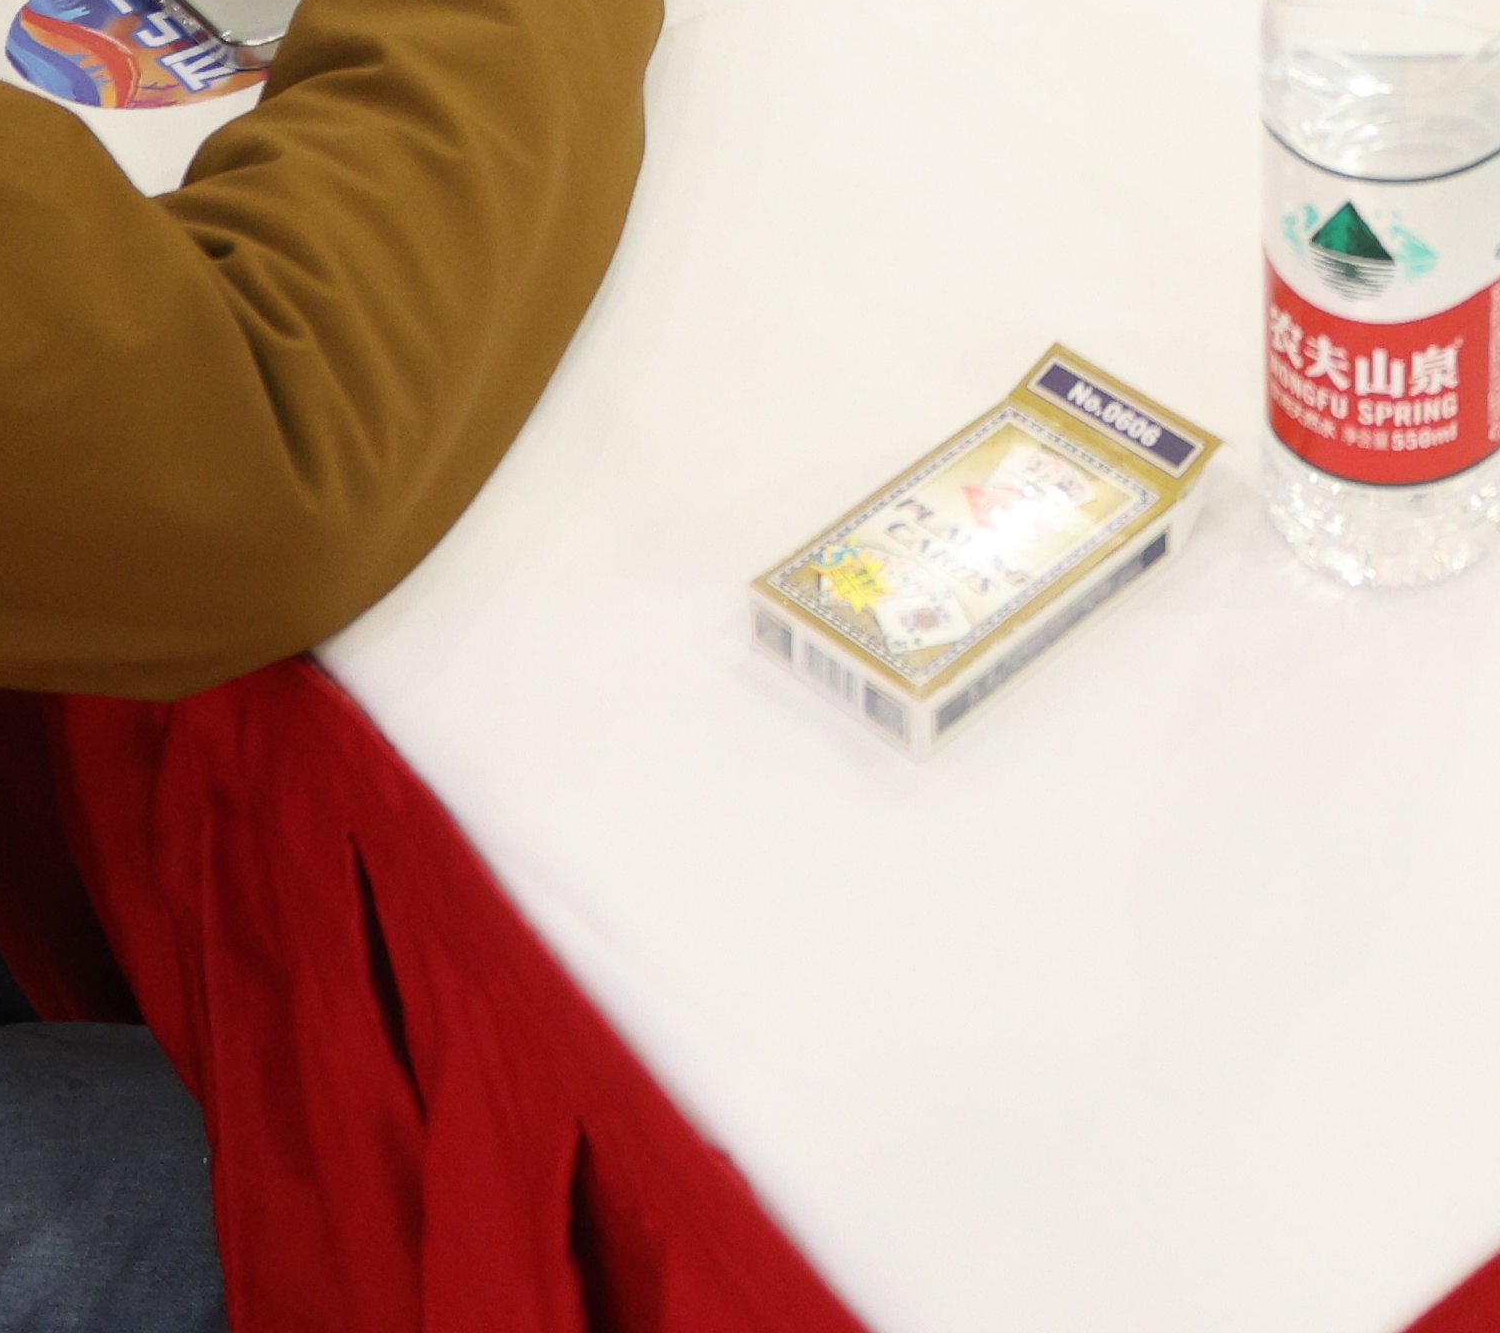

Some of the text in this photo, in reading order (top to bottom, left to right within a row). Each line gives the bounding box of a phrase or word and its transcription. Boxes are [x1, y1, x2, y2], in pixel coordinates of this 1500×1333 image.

[1269, 303, 1461, 399] 农夫山泉
[1066, 381, 1163, 449] No.0606
[1356, 390, 1460, 428] SPRING
